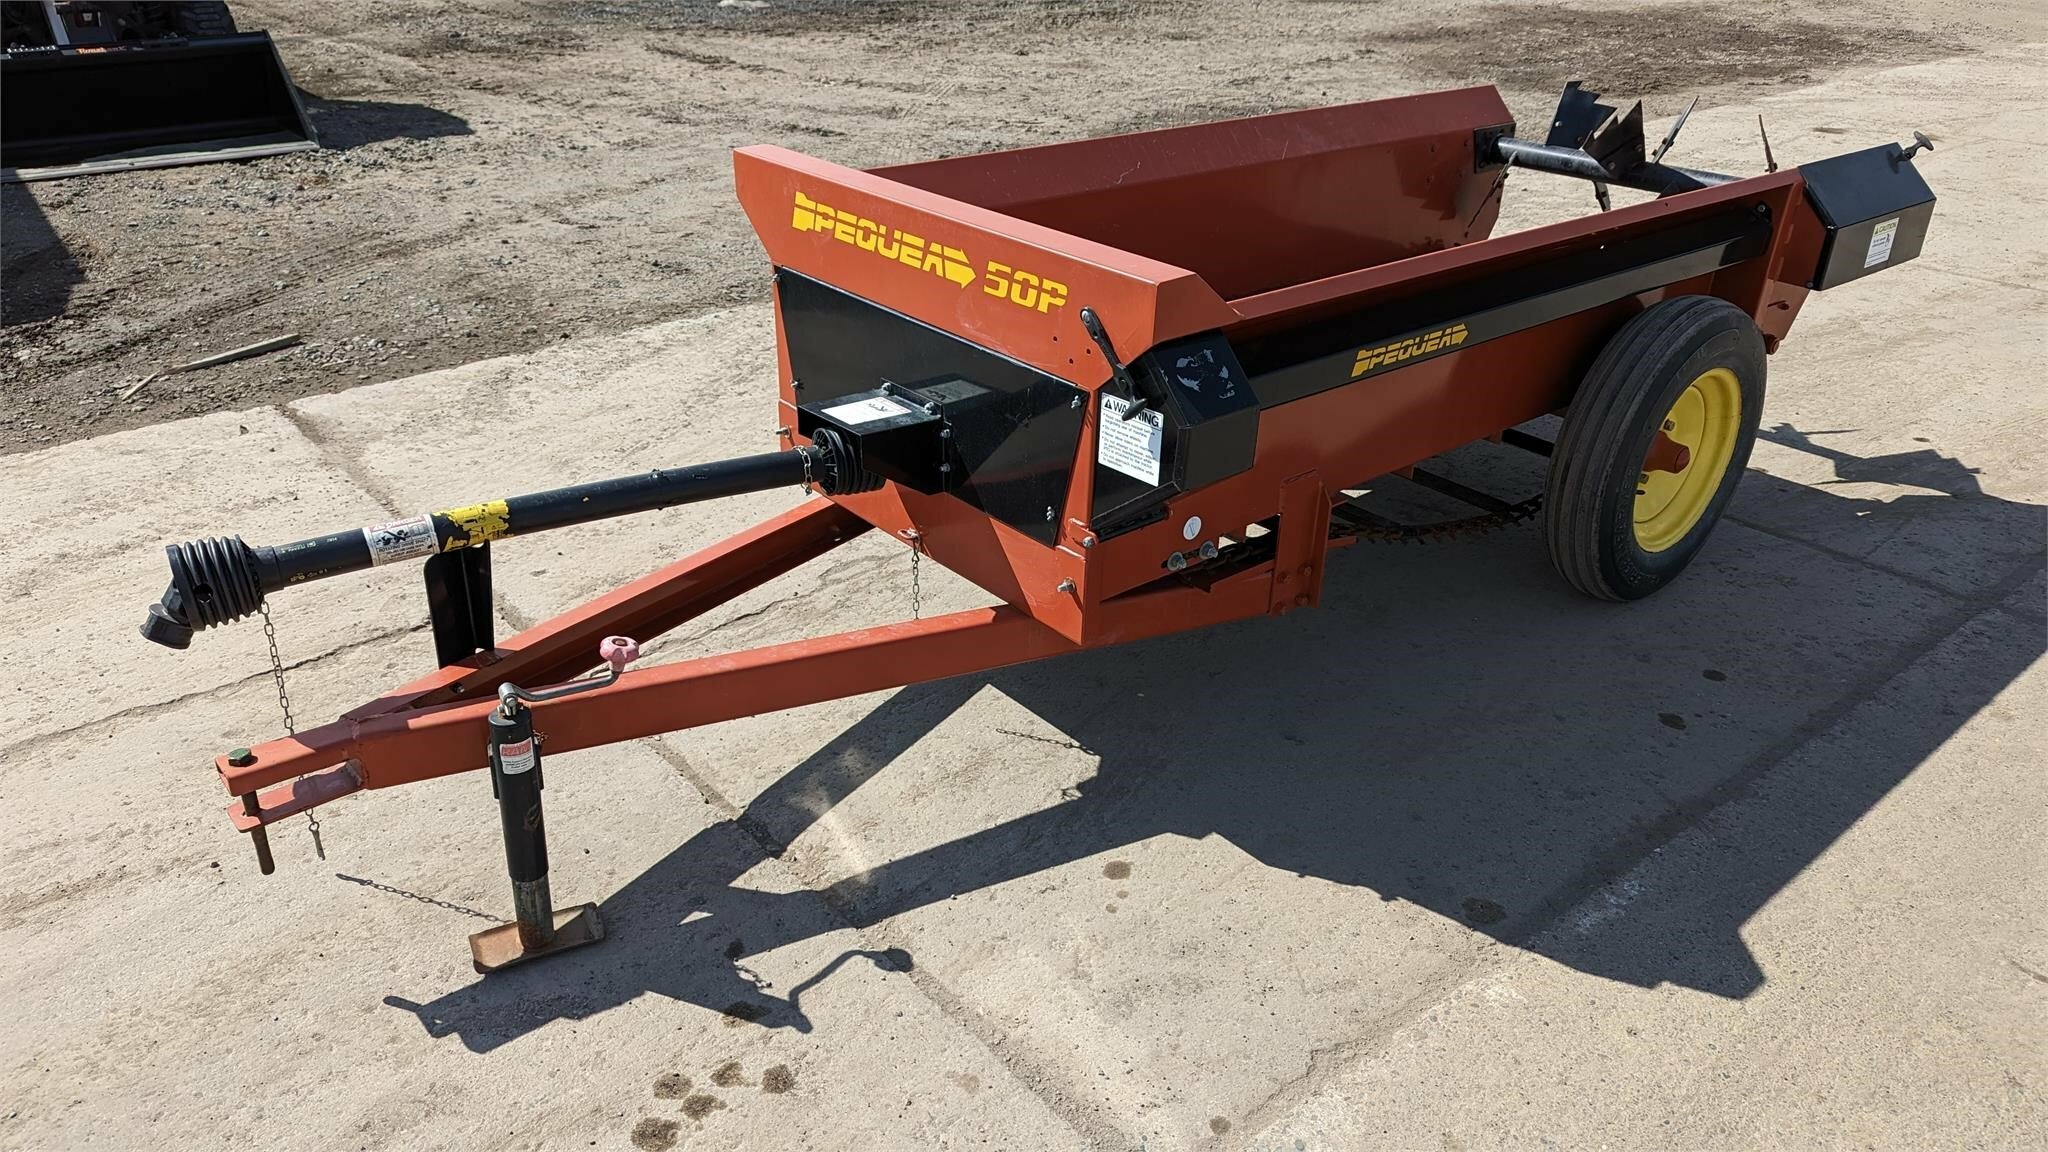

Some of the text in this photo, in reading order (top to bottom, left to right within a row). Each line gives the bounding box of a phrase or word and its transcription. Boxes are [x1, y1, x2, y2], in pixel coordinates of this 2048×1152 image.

[812, 201, 1069, 314] PEQUEA 50P
[1367, 327, 1454, 371] PEQUEA
[1112, 400, 1160, 428] WANING
